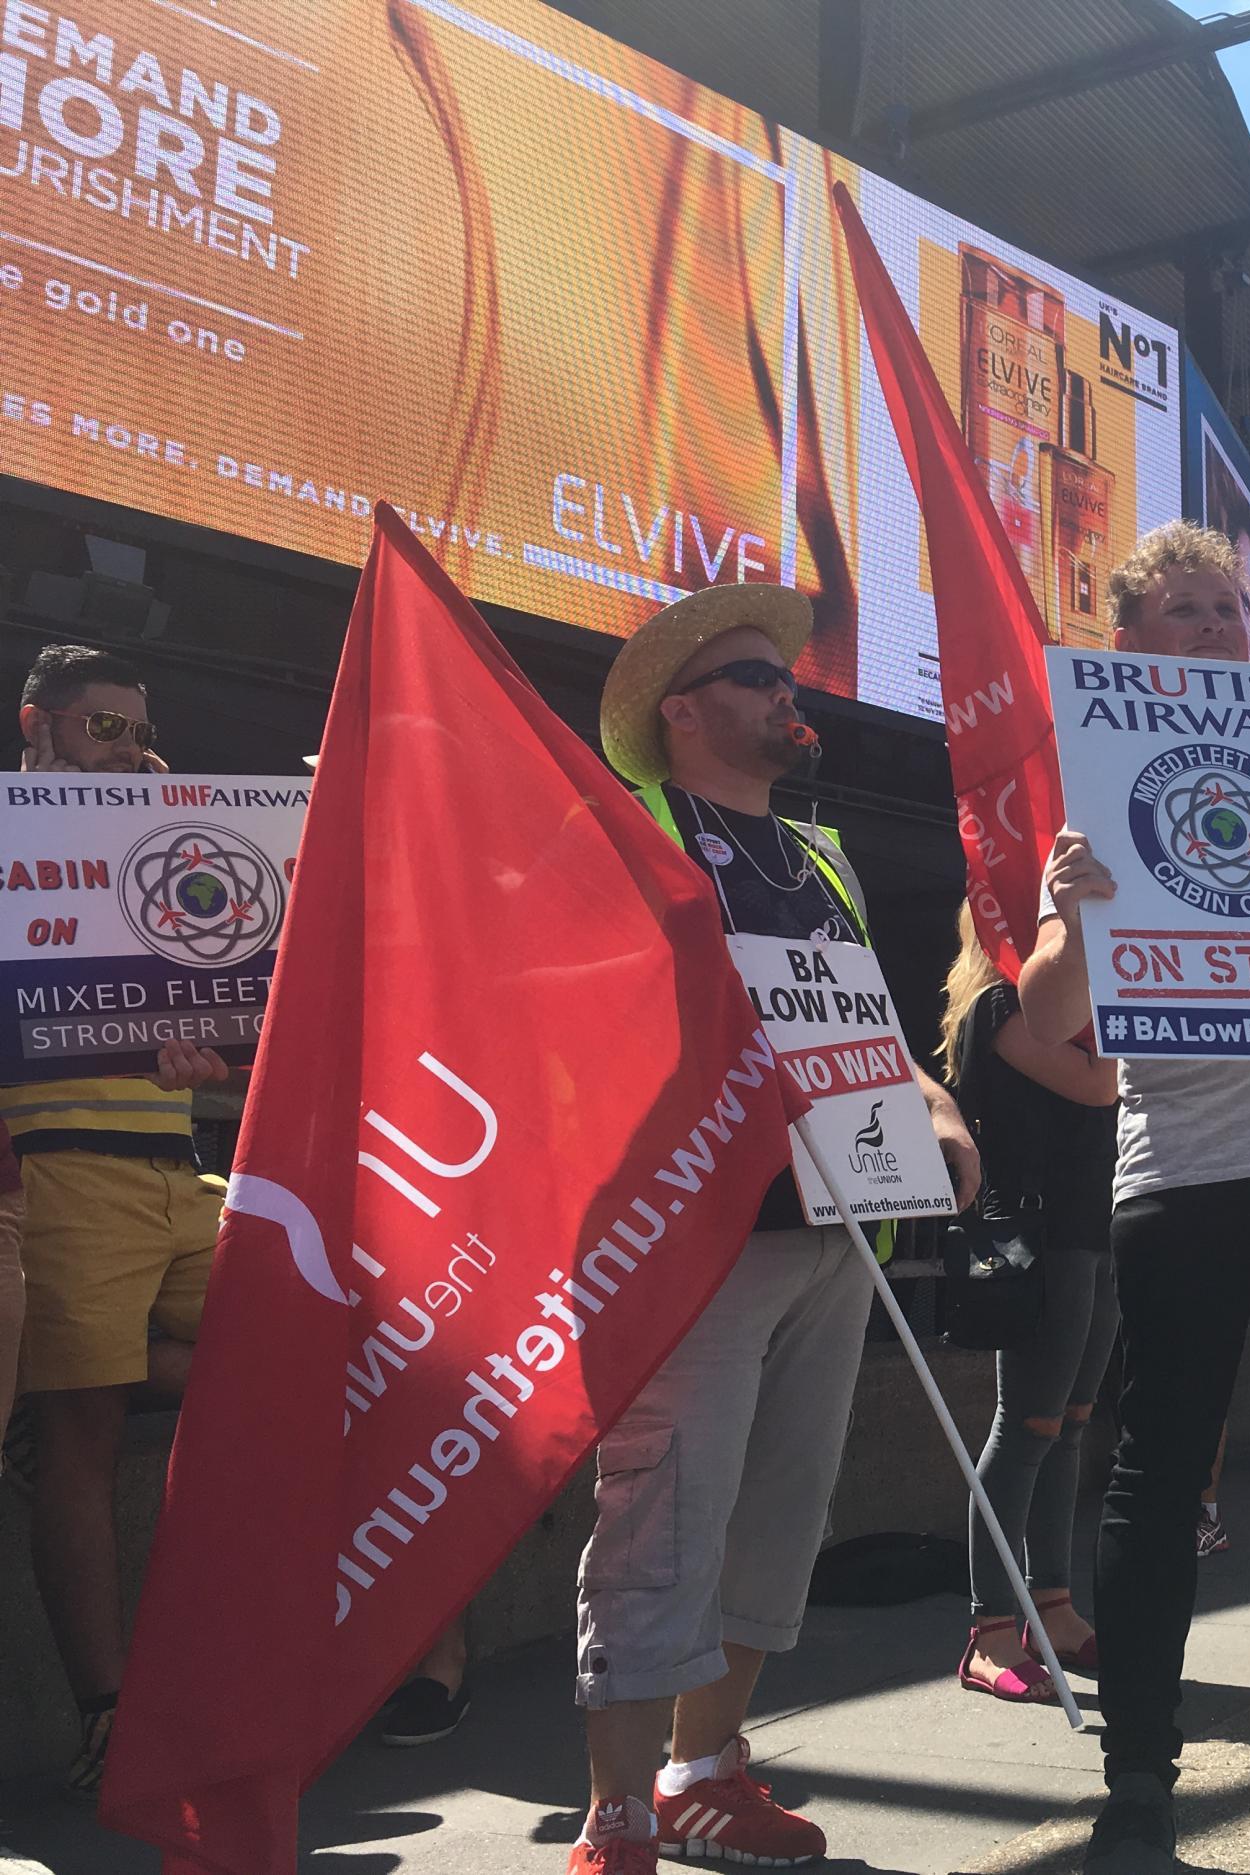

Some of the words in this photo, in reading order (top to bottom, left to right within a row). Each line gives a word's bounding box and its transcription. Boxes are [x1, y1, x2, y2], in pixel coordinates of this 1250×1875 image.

[45, 279, 148, 331] gold
[167, 320, 246, 362] one
[977, 346, 1052, 402] ELVIVE
[216, 454, 371, 518] DEMAND
[396, 507, 513, 558] LVIVE.
[8, 786, 150, 807] BRITISH
[161, 784, 312, 808] UNFAIRWA
[1133, 752, 1184, 806] MIXED
[1183, 746, 1249, 771] FLEET
[1153, 861, 1230, 914] CABIN
[27, 917, 78, 946] ON
[785, 948, 839, 985] BA
[1111, 943, 1185, 983] ON
[16, 982, 147, 1014] MIXED
[747, 986, 829, 1023] LOW
[832, 991, 891, 1026] PAY
[31, 1016, 219, 1050] STRONGER
[832, 1043, 902, 1085] WAY
